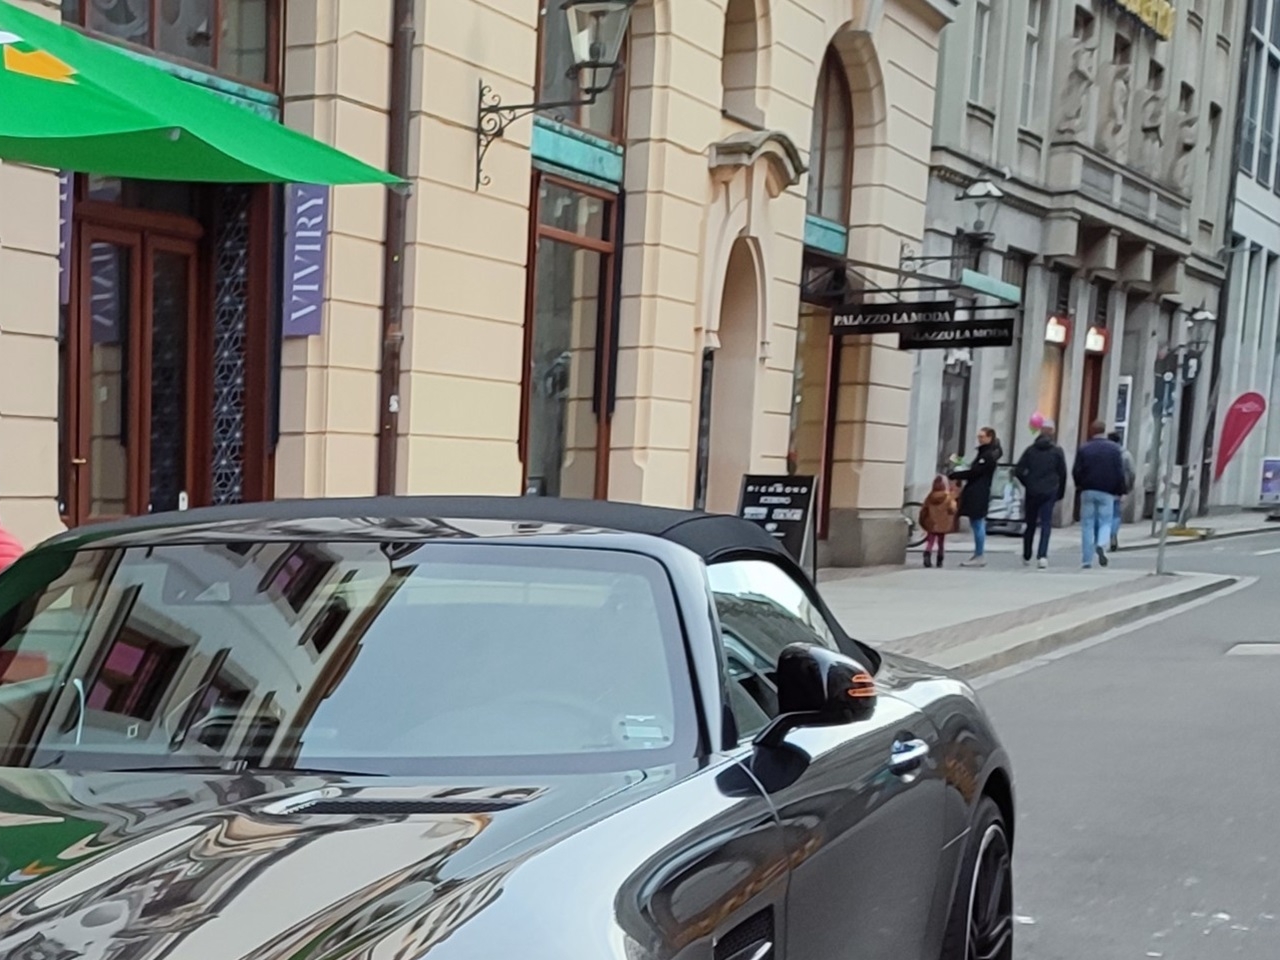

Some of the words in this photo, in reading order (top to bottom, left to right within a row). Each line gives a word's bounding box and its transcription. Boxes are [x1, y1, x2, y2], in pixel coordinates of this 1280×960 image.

[290, 189, 324, 321] VIVIRY
[833, 313, 890, 326] PALAZZO
[892, 312, 910, 324] LA
[910, 310, 951, 323] MODA
[955, 329, 971, 341] LA
